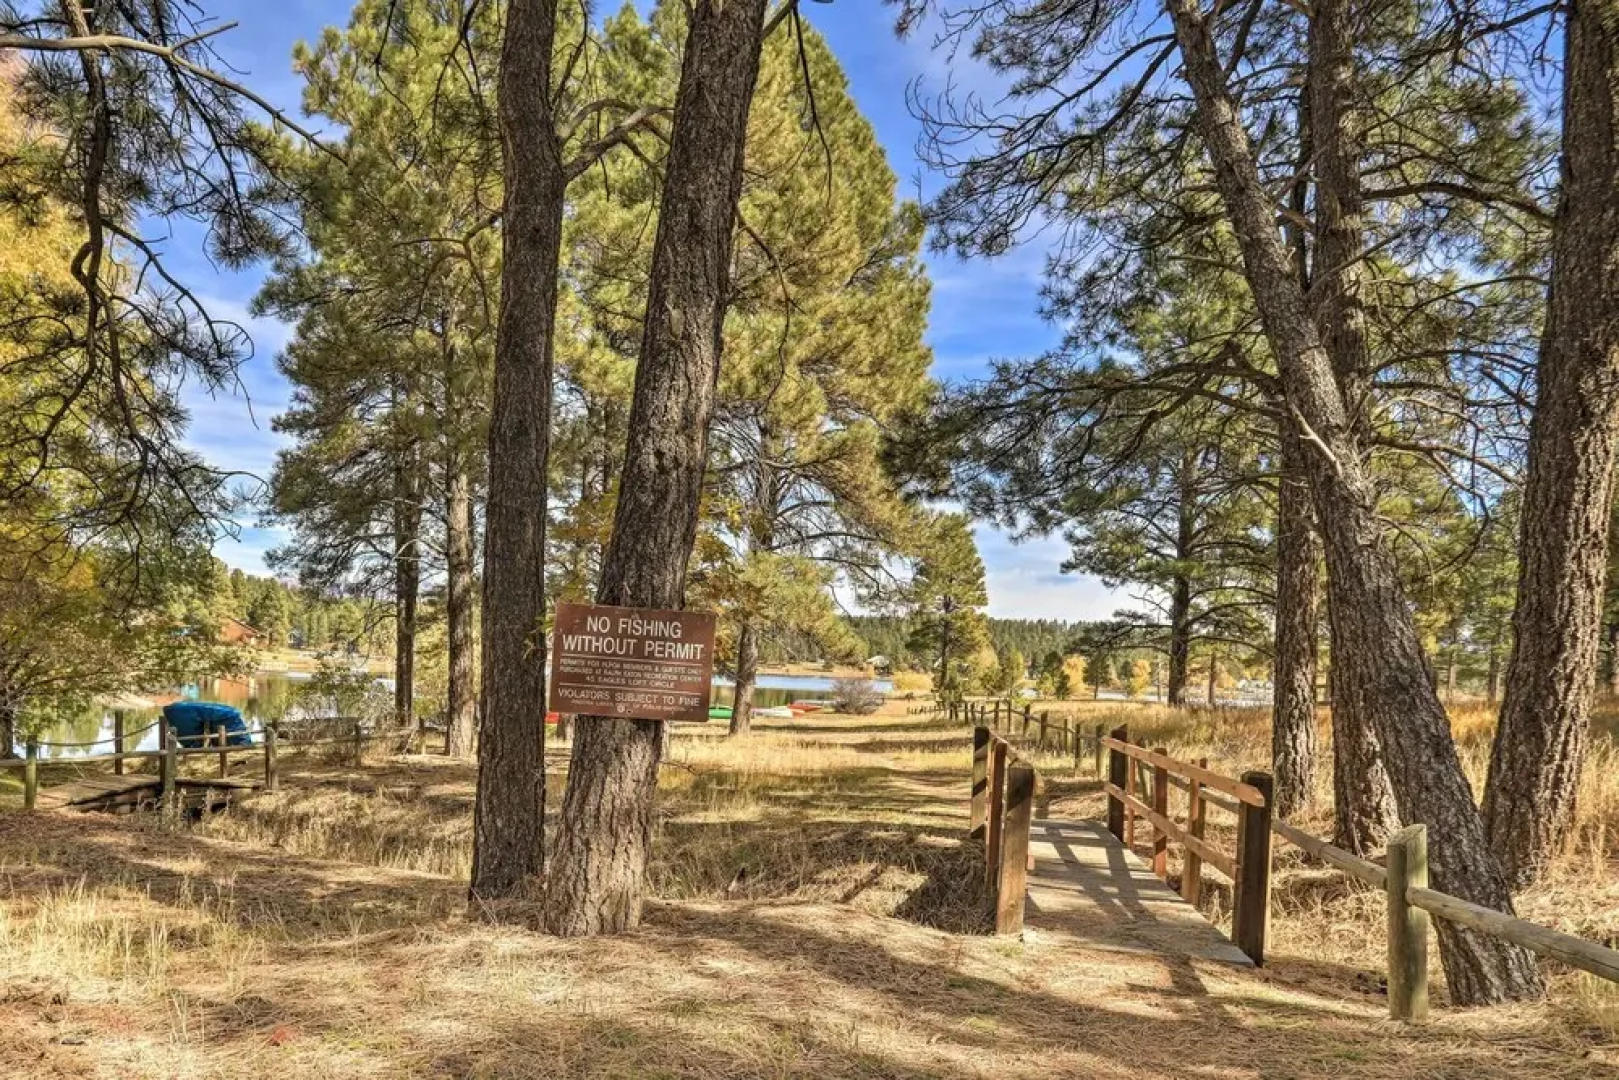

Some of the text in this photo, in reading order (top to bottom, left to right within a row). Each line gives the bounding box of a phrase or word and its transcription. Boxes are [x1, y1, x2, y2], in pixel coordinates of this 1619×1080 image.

[587, 615, 682, 639] NO FISHING
[563, 635, 704, 659] WITHOUT PERMIT
[651, 680, 675, 688] CIRCLE
[558, 688, 700, 706] VIOLATORS SUBJECT TO FINE
